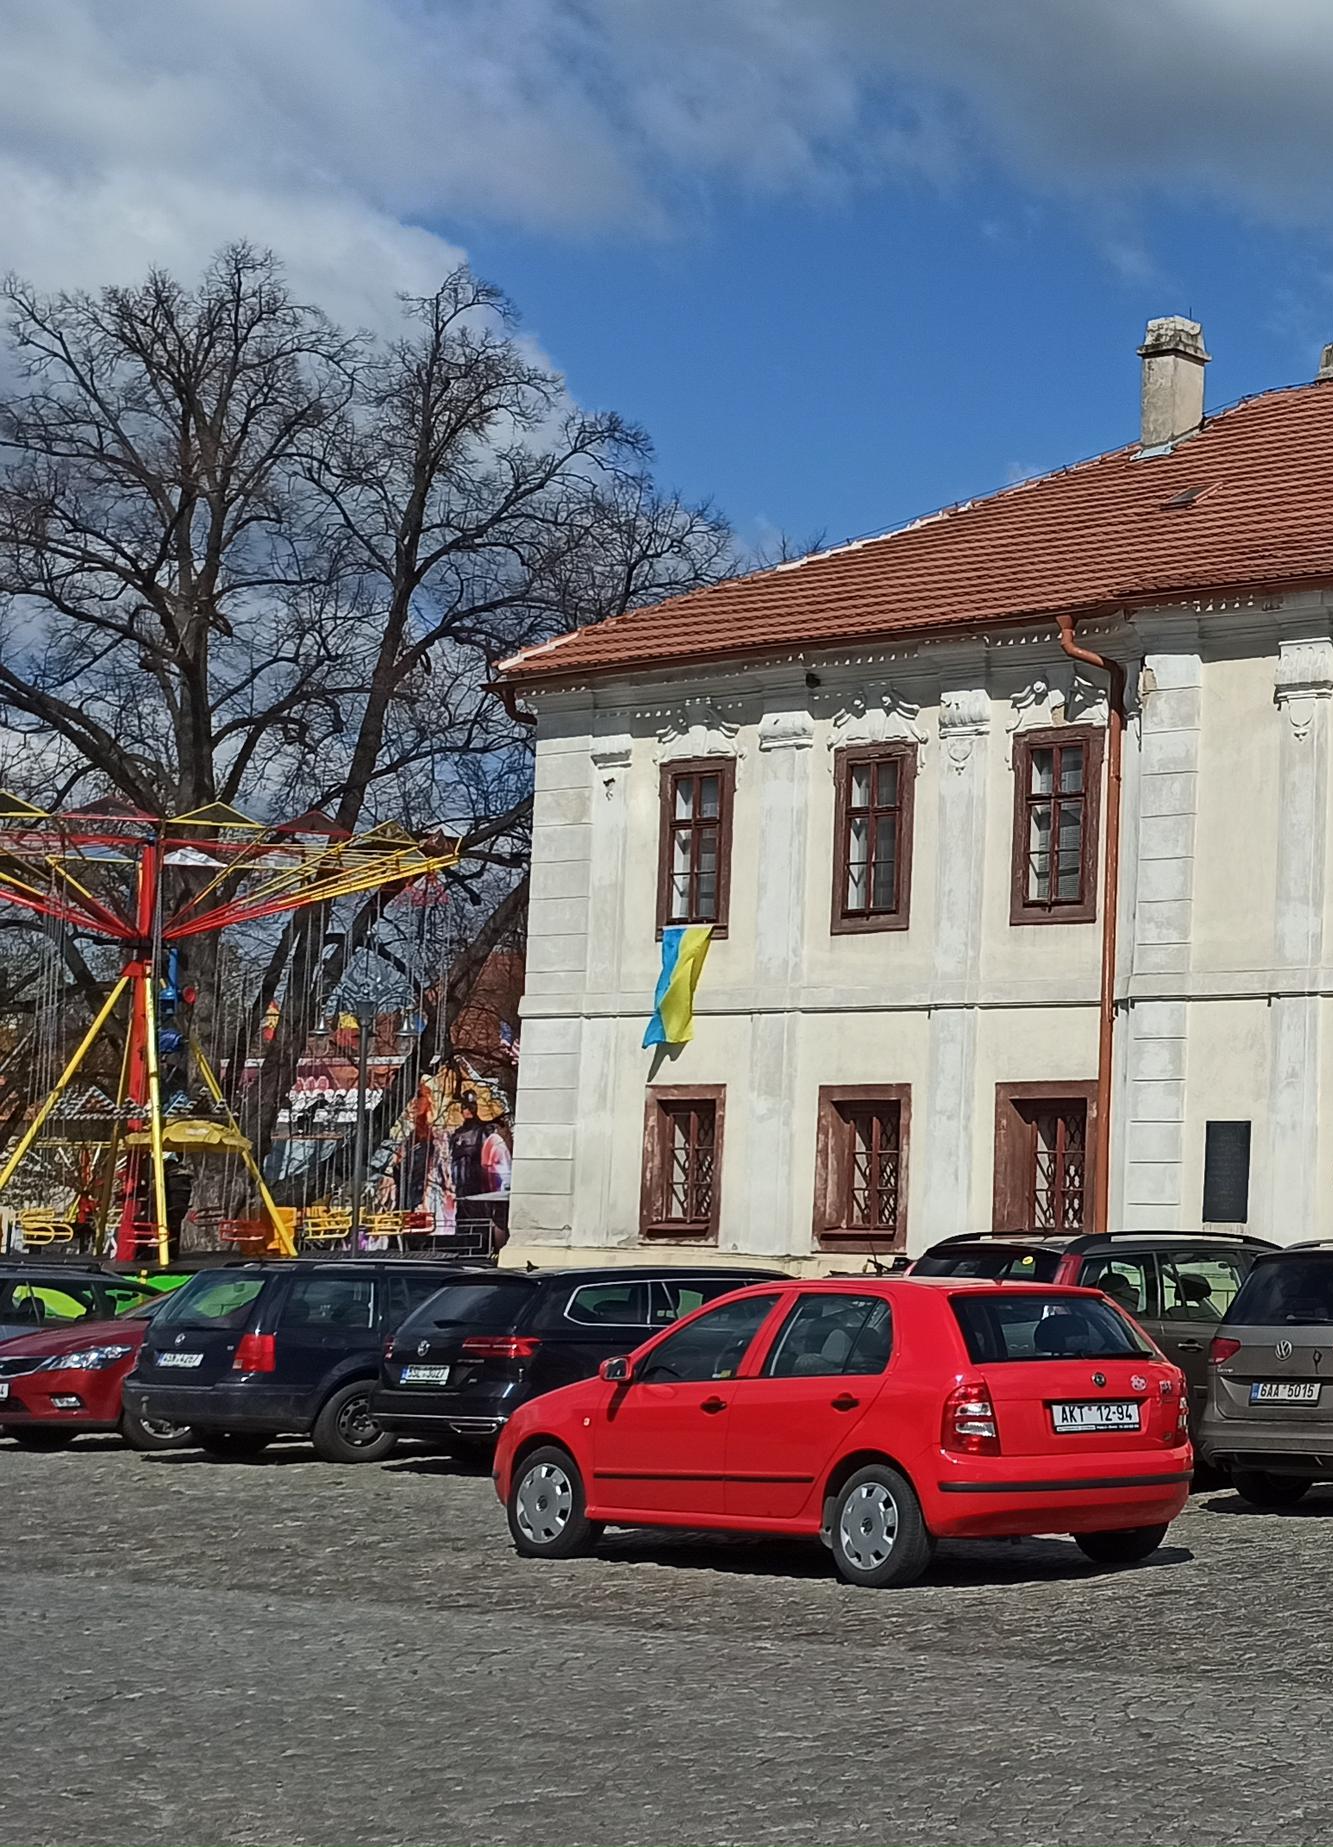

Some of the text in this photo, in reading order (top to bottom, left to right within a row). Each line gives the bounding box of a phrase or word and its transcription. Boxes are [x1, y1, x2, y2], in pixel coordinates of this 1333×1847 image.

[1287, 1384, 1315, 1399] 5015
[1061, 1404, 1133, 1424] AKT 12-94
